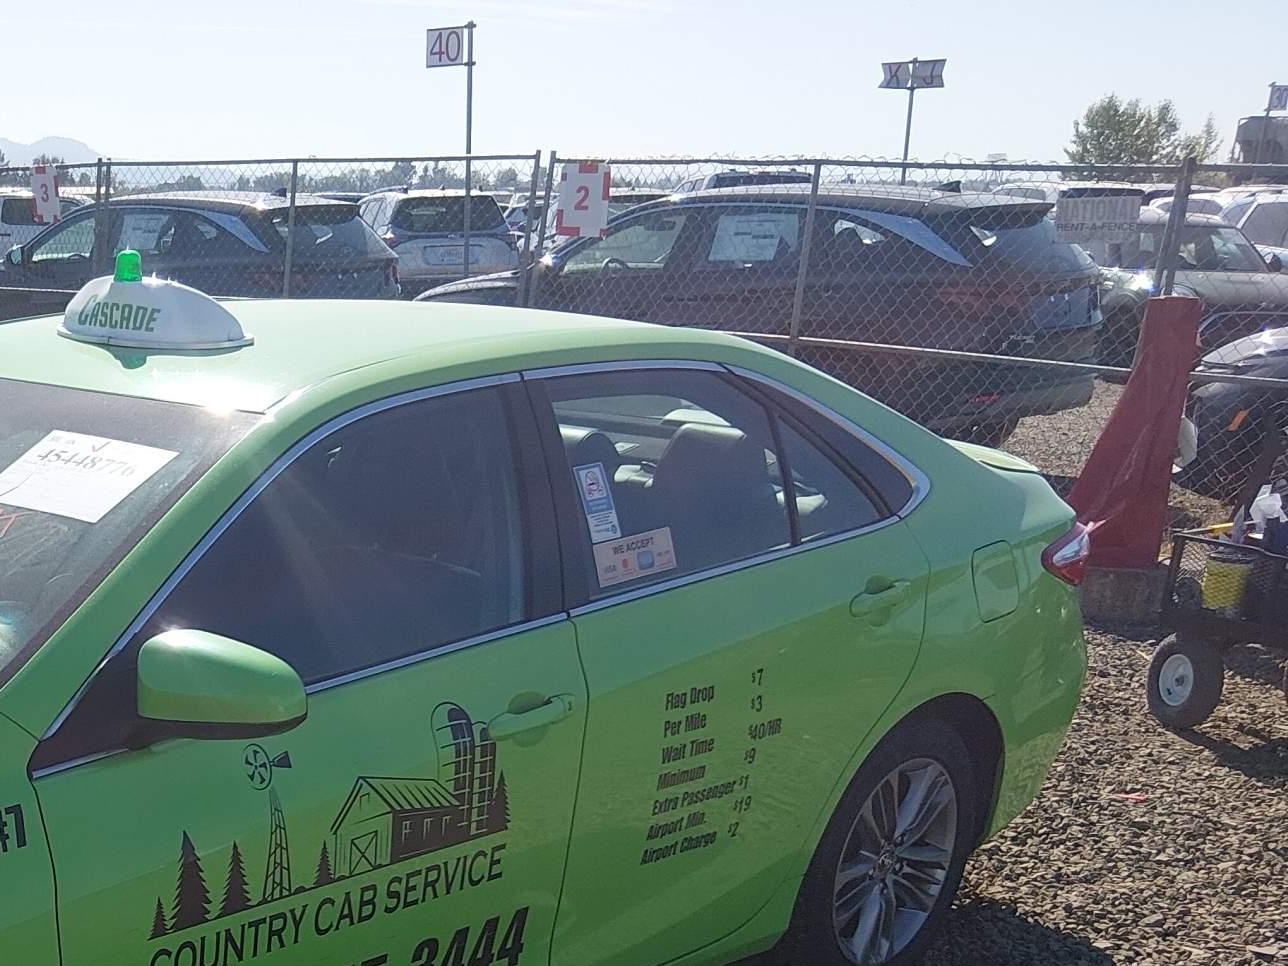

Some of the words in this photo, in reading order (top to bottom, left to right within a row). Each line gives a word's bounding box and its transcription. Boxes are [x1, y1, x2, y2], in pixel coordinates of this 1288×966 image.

[429, 30, 461, 62] 40
[922, 62, 938, 86] J
[39, 183, 49, 203] 3
[574, 185, 590, 210] 2
[1057, 197, 1139, 221] NATIONAL
[1056, 222, 1137, 232] RENT-A-FENCE
[78, 294, 162, 332] CASCADE
[36, 448, 136, 478] 45448776
[612, 544, 625, 555] WE
[626, 537, 655, 551] ACCEPT
[665, 692, 687, 711] Flag
[690, 685, 715, 704] Drop
[751, 668, 764, 686] $7
[663, 720, 682, 738] Per
[684, 712, 707, 732] Mile
[750, 695, 763, 712] $3
[661, 743, 685, 765] Wait
[689, 738, 715, 756] Time
[748, 718, 782, 741] $40/HR
[656, 765, 706, 791] Minimum
[743, 747, 756, 764] $9
[652, 798, 679, 816] Extra
[680, 779, 737, 808] Passenger
[738, 774, 750, 790] $1
[646, 817, 684, 841] Airport
[685, 811, 707, 829] Min.
[732, 796, 752, 814] $19
[640, 840, 679, 865] Airport
[679, 831, 717, 854] Charge
[727, 822, 740, 838] $2
[314, 884, 377, 936] CAB
[384, 843, 506, 914] SERVICE
